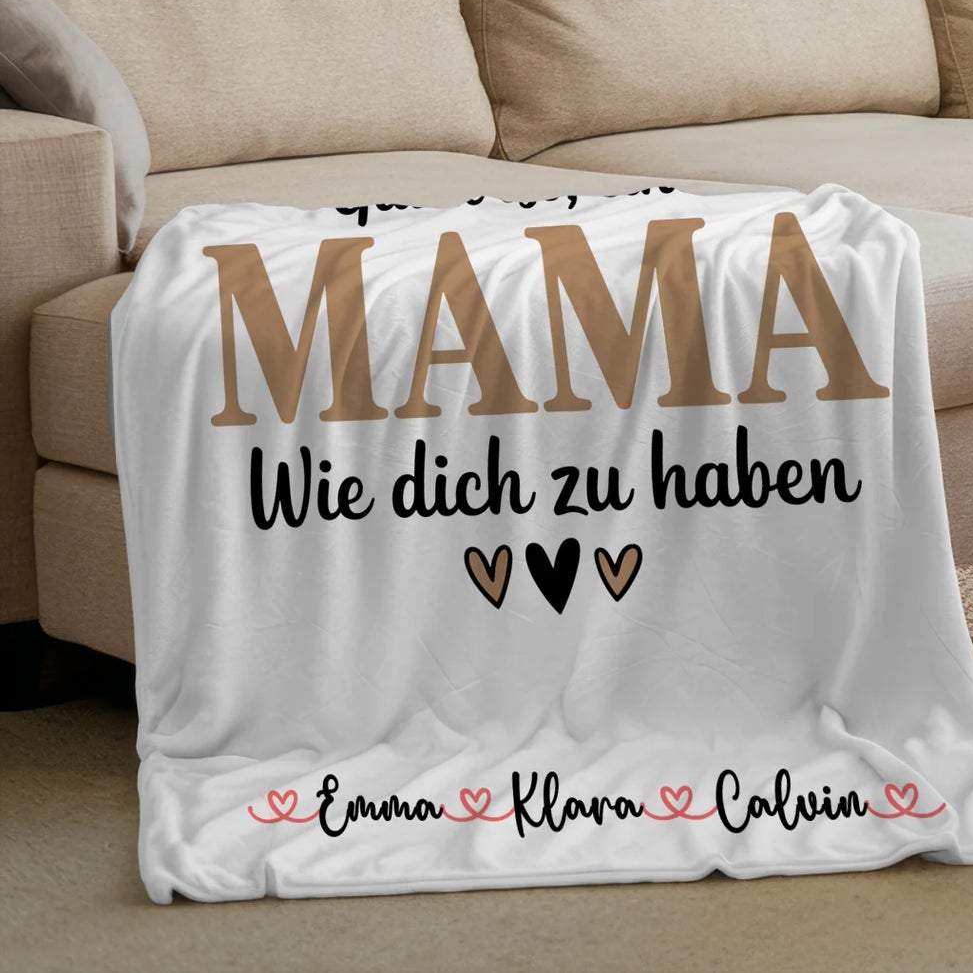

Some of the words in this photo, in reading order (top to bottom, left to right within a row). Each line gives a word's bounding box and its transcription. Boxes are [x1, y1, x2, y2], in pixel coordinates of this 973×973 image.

[204, 212, 889, 426] MAMA
[251, 446, 374, 530] Wie
[393, 436, 536, 518] dich
[551, 466, 634, 515] zu
[652, 425, 862, 509] haben
[317, 775, 443, 837] Emma
[512, 772, 643, 837] Klara
[716, 769, 867, 833] Calvin
